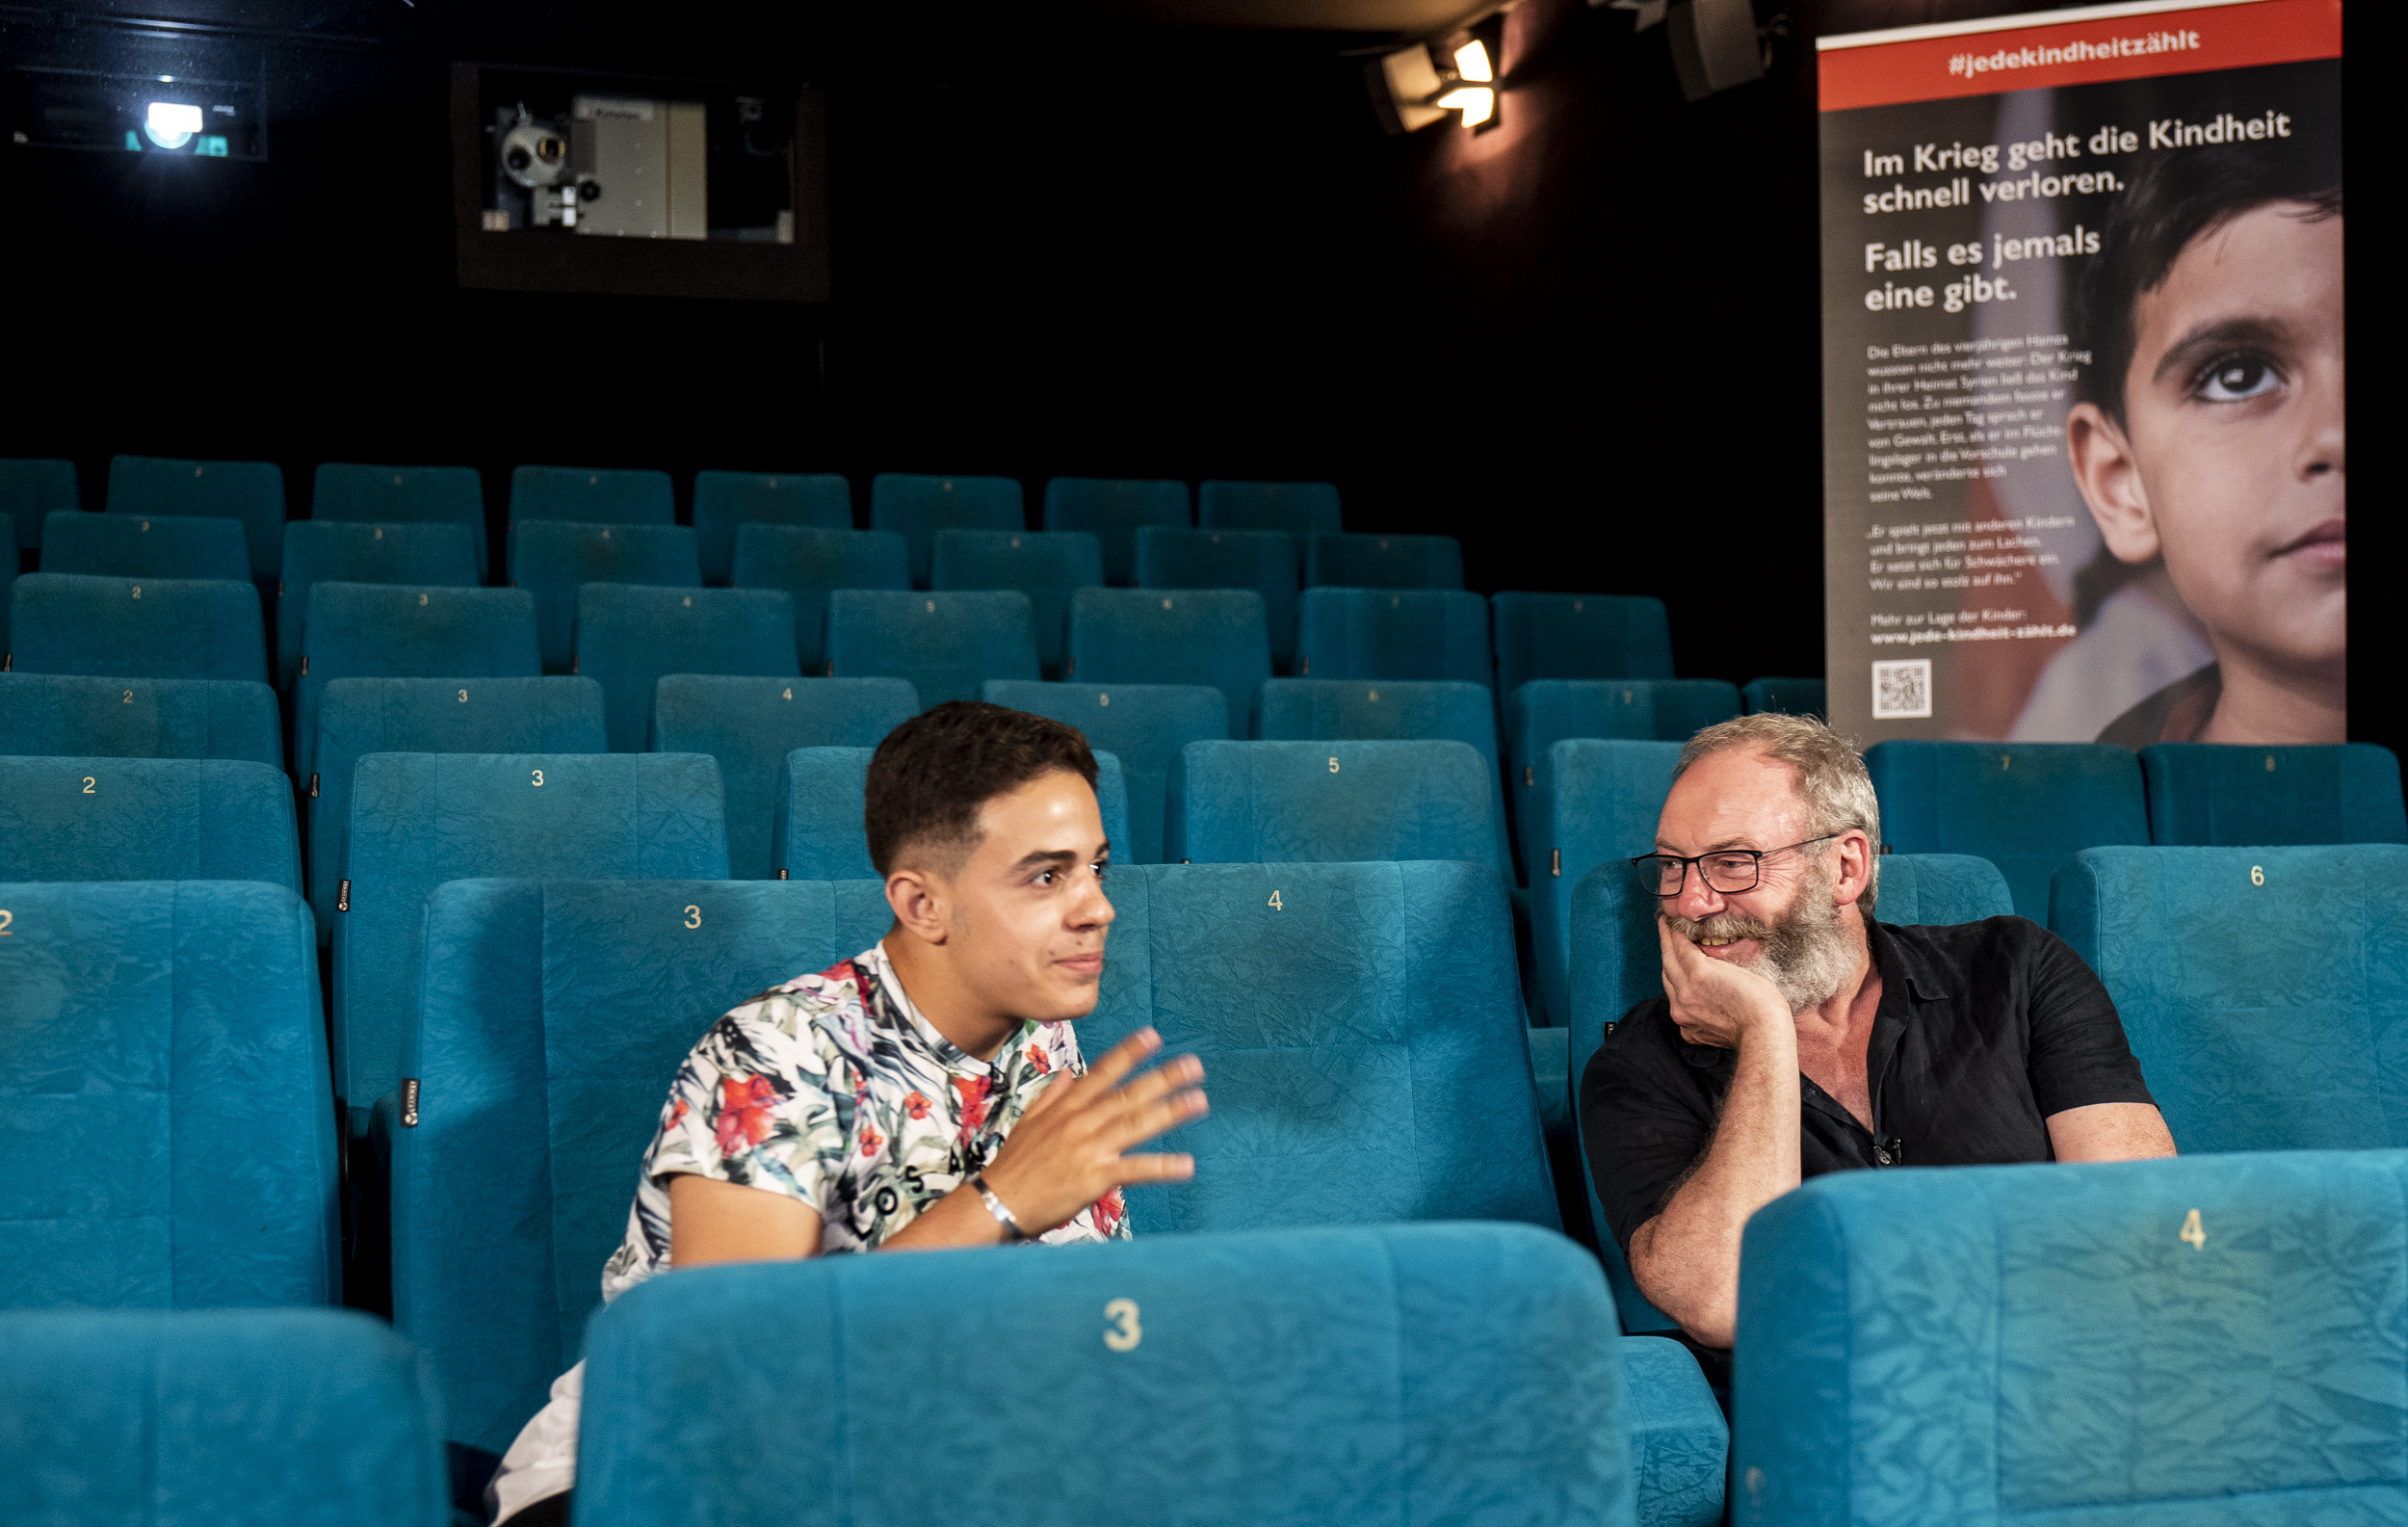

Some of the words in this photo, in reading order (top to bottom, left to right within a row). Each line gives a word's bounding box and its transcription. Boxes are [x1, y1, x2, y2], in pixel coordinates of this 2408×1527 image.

[1948, 30, 2201, 79] #jedekindheitzählt
[1864, 149, 1904, 178] Im
[1913, 142, 2000, 176] Krieg
[2008, 131, 2081, 172] geht
[2088, 125, 2138, 156] die
[2148, 111, 2291, 150] Kindheit
[1863, 177, 1970, 215] schnell
[1979, 169, 2125, 203] verloren.
[1865, 238, 1937, 273] Falls
[1948, 238, 1983, 266] es
[1991, 225, 2101, 269] jemals
[1864, 281, 1934, 311] eine
[1942, 275, 2017, 313] gibt.
[132, 586, 142, 599] 2
[418, 593, 429, 606] 3
[122, 690, 134, 704] 2
[457, 689, 468, 703] 3
[782, 688, 794, 701] 4
[1099, 693, 1110, 707] 5
[1328, 757, 1340, 773] 5
[83, 777, 95, 794] 2
[531, 770, 544, 787] 3
[2250, 864, 2265, 887] 6
[1268, 889, 1284, 911] 4
[683, 905, 701, 931] 3
[2180, 1208, 2207, 1251] 4
[1103, 1297, 1142, 1352] 3
